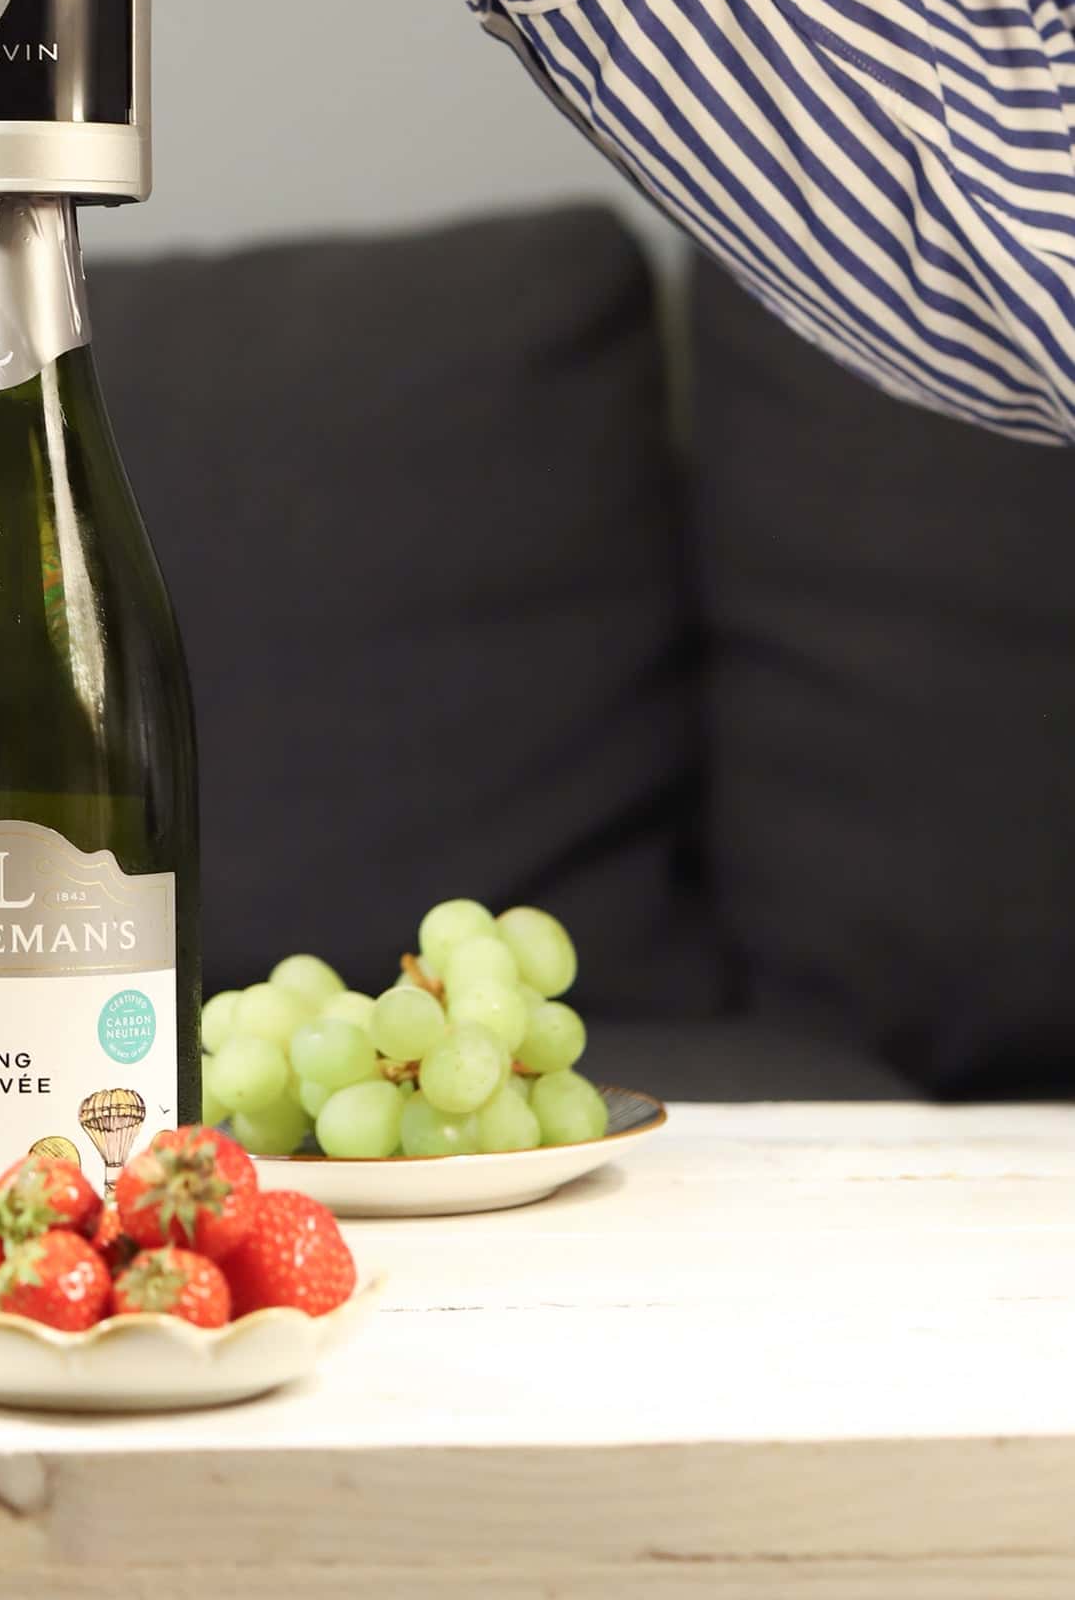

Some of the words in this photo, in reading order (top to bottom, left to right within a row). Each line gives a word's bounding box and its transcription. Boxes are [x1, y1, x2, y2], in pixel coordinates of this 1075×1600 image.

[56, 891, 87, 902] 1843
[106, 1015, 152, 1028] CARBON
[106, 1027, 151, 1040] NEUTRAL
